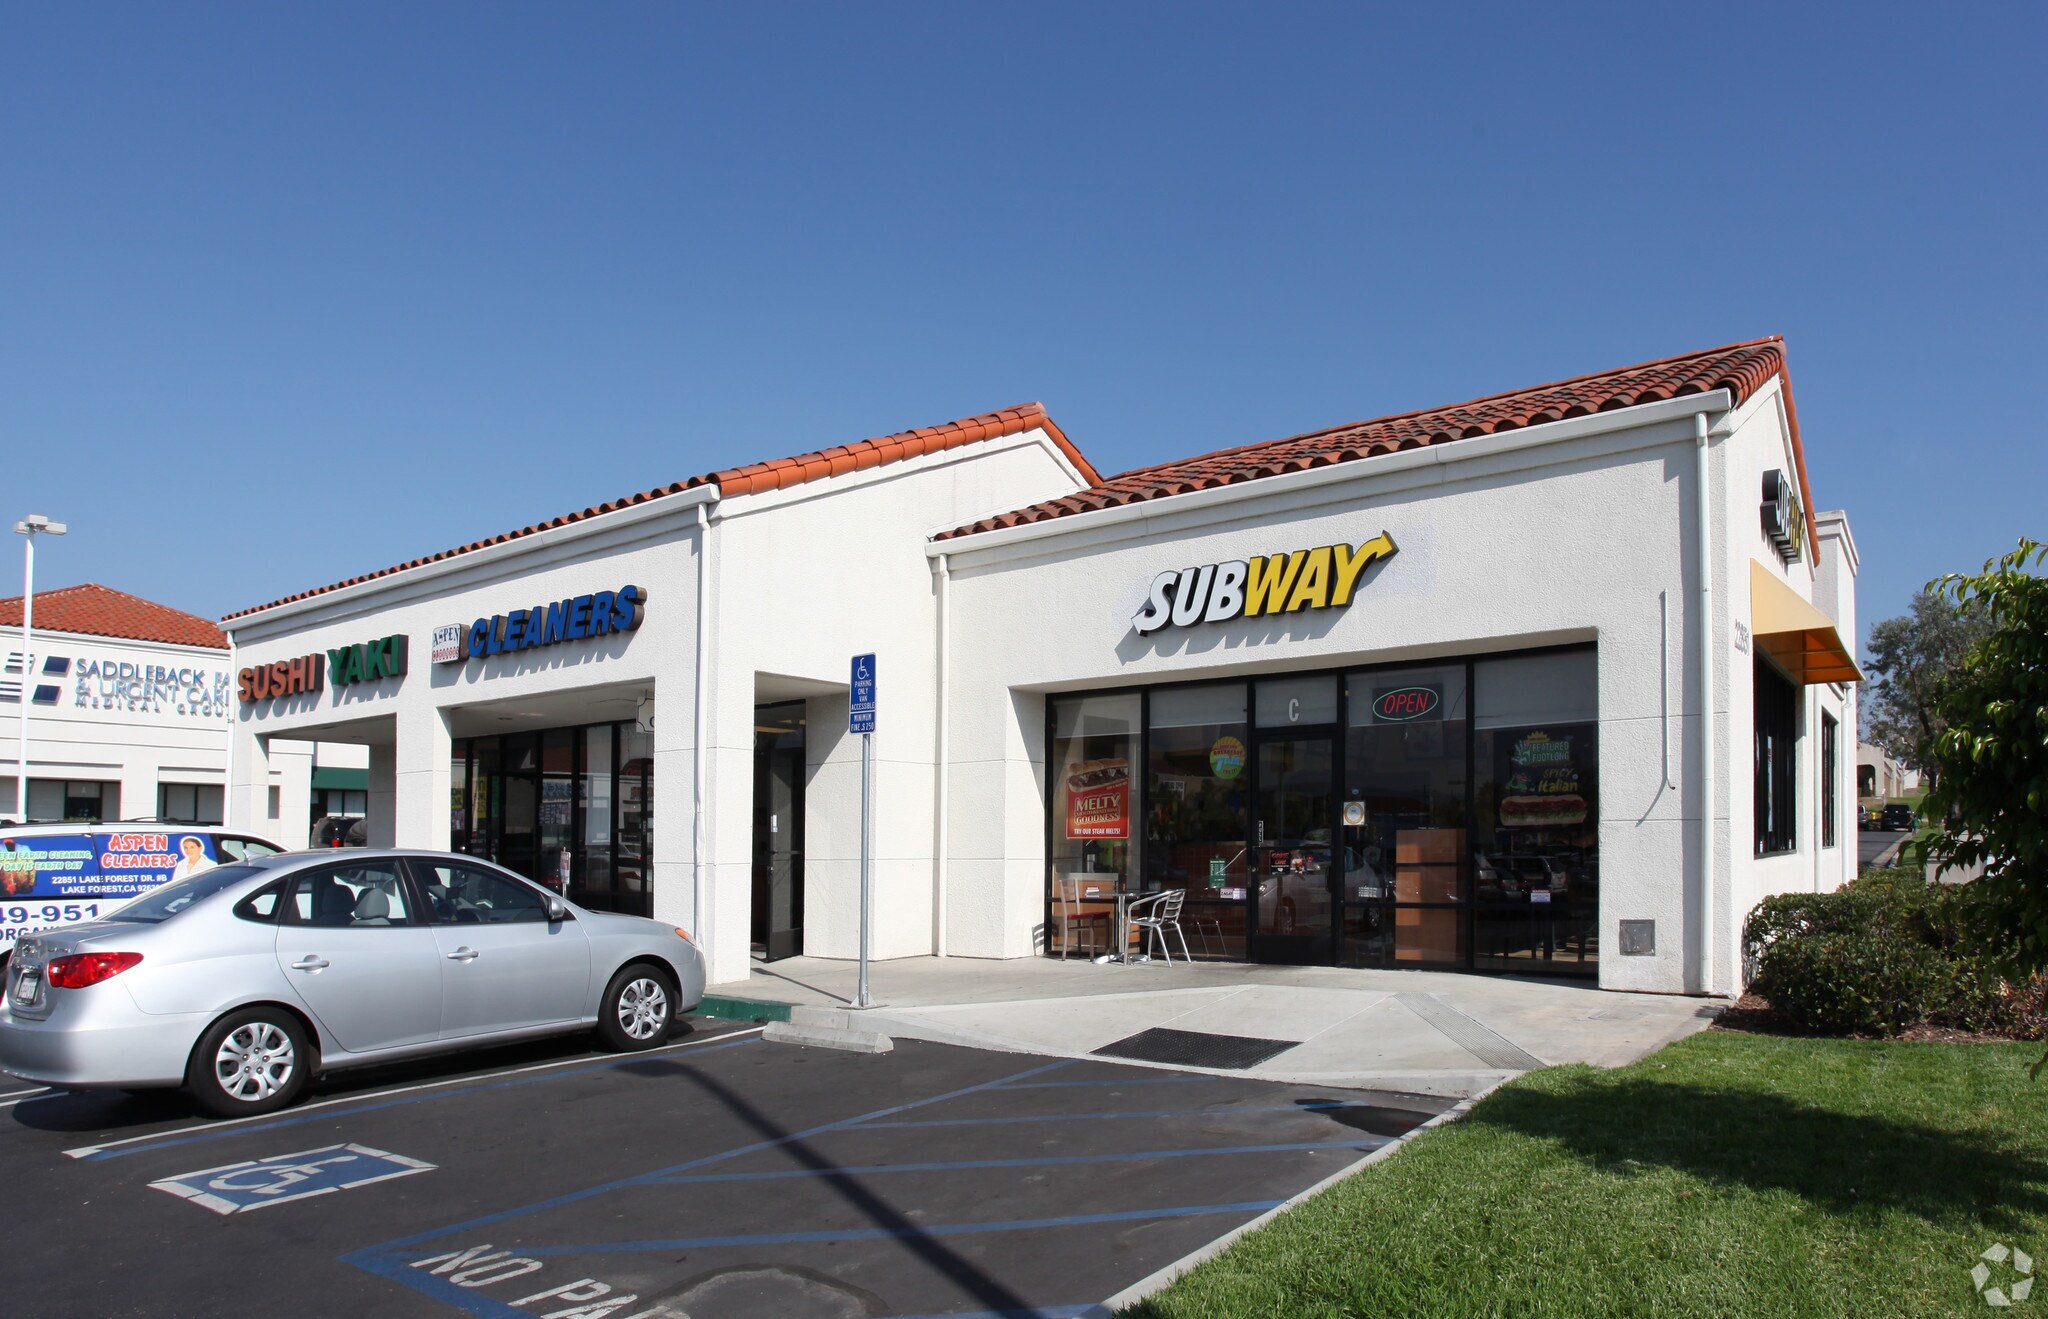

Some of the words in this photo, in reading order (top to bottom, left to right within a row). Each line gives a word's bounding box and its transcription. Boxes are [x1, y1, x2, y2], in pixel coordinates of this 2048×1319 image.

[1130, 529, 1400, 637] SUBWAY
[467, 584, 647, 658] CLEANERS
[433, 627, 460, 648] ASPEN
[76, 658, 205, 688] SADDLEBACK
[237, 653, 325, 702] SUSHI
[326, 633, 409, 687] YAKI
[75, 678, 91, 697] &
[100, 680, 180, 703] URGENT
[854, 680, 872, 688] PARKING
[857, 687, 869, 695] ONLY
[75, 696, 160, 713] MEDICAL
[177, 702, 229, 718] GROU
[851, 702, 875, 711] ACCESSIBLE
[1288, 698, 1300, 722] C
[1383, 692, 1430, 714] OPEN
[854, 713, 872, 722] MINIMUM
[851, 723, 861, 732] FINE
[1531, 742, 1570, 752] FEATURED
[1531, 751, 1570, 762] FOOTLONG
[1543, 768, 1575, 779] SPICY
[1538, 778, 1579, 793] Italian
[1076, 794, 1120, 812] MELTY
[1076, 812, 1120, 823] GOODNESS
[108, 834, 169, 852] ASPEN
[17, 851, 48, 860] EARTH
[48, 850, 94, 860] CLEANING,
[102, 852, 179, 869] CLEANERS
[3, 861, 23, 872] DAY
[23, 861, 35, 871] IS
[35, 861, 65, 871] EARTH
[65, 860, 84, 870] DAY
[51, 876, 77, 885] 22851
[79, 875, 104, 884] LAKE
[105, 874, 140, 883] FOREST
[140, 874, 155, 883] DR.
[156, 874, 168, 882] #B
[61, 885, 86, 895] LAKE
[409, 1243, 544, 1288] NO
[507, 1277, 691, 1319] PA
